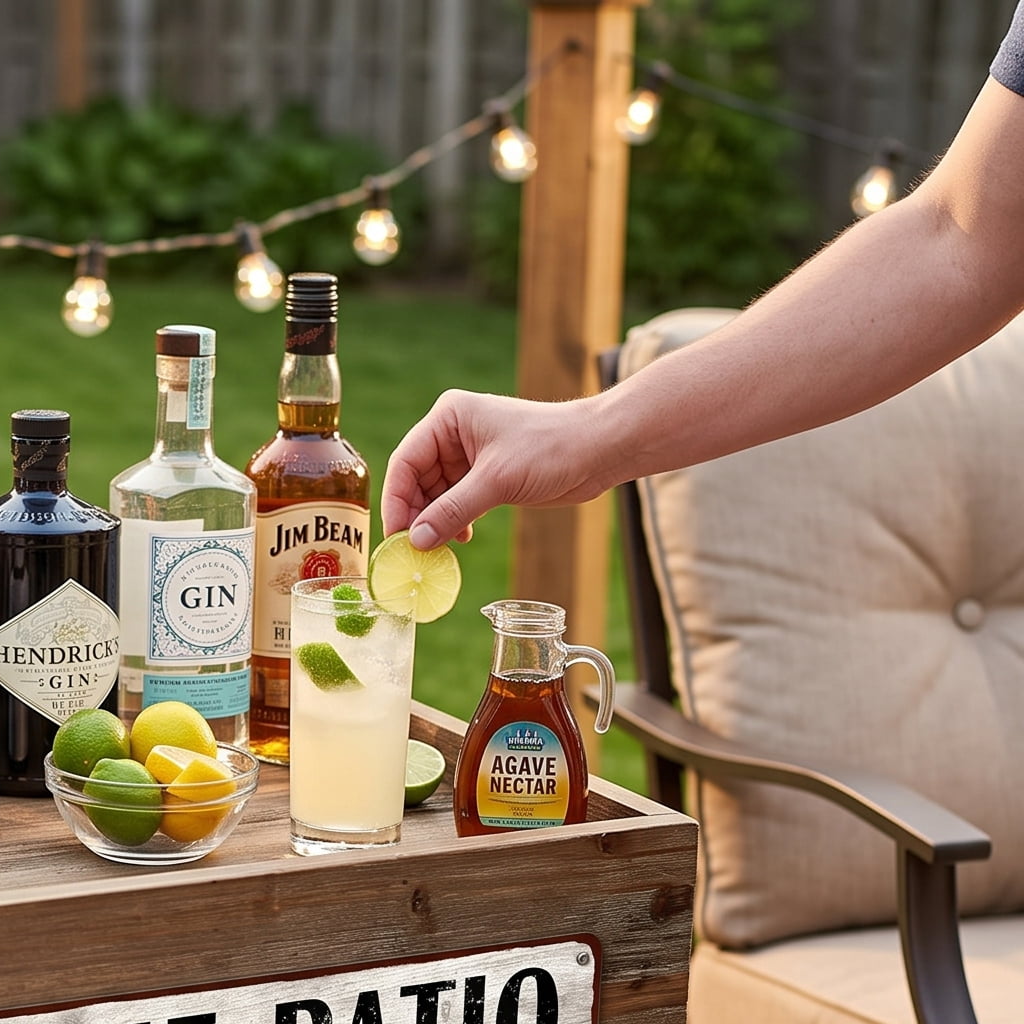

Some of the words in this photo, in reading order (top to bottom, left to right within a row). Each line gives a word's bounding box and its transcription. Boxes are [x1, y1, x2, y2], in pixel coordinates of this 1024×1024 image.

[270, 524, 309, 557] JIM
[314, 515, 363, 554] BEAM
[180, 583, 238, 609] GIN
[49, 673, 91, 690] GIN
[491, 755, 557, 776] AGAVE
[490, 777, 557, 795] NECTAR
